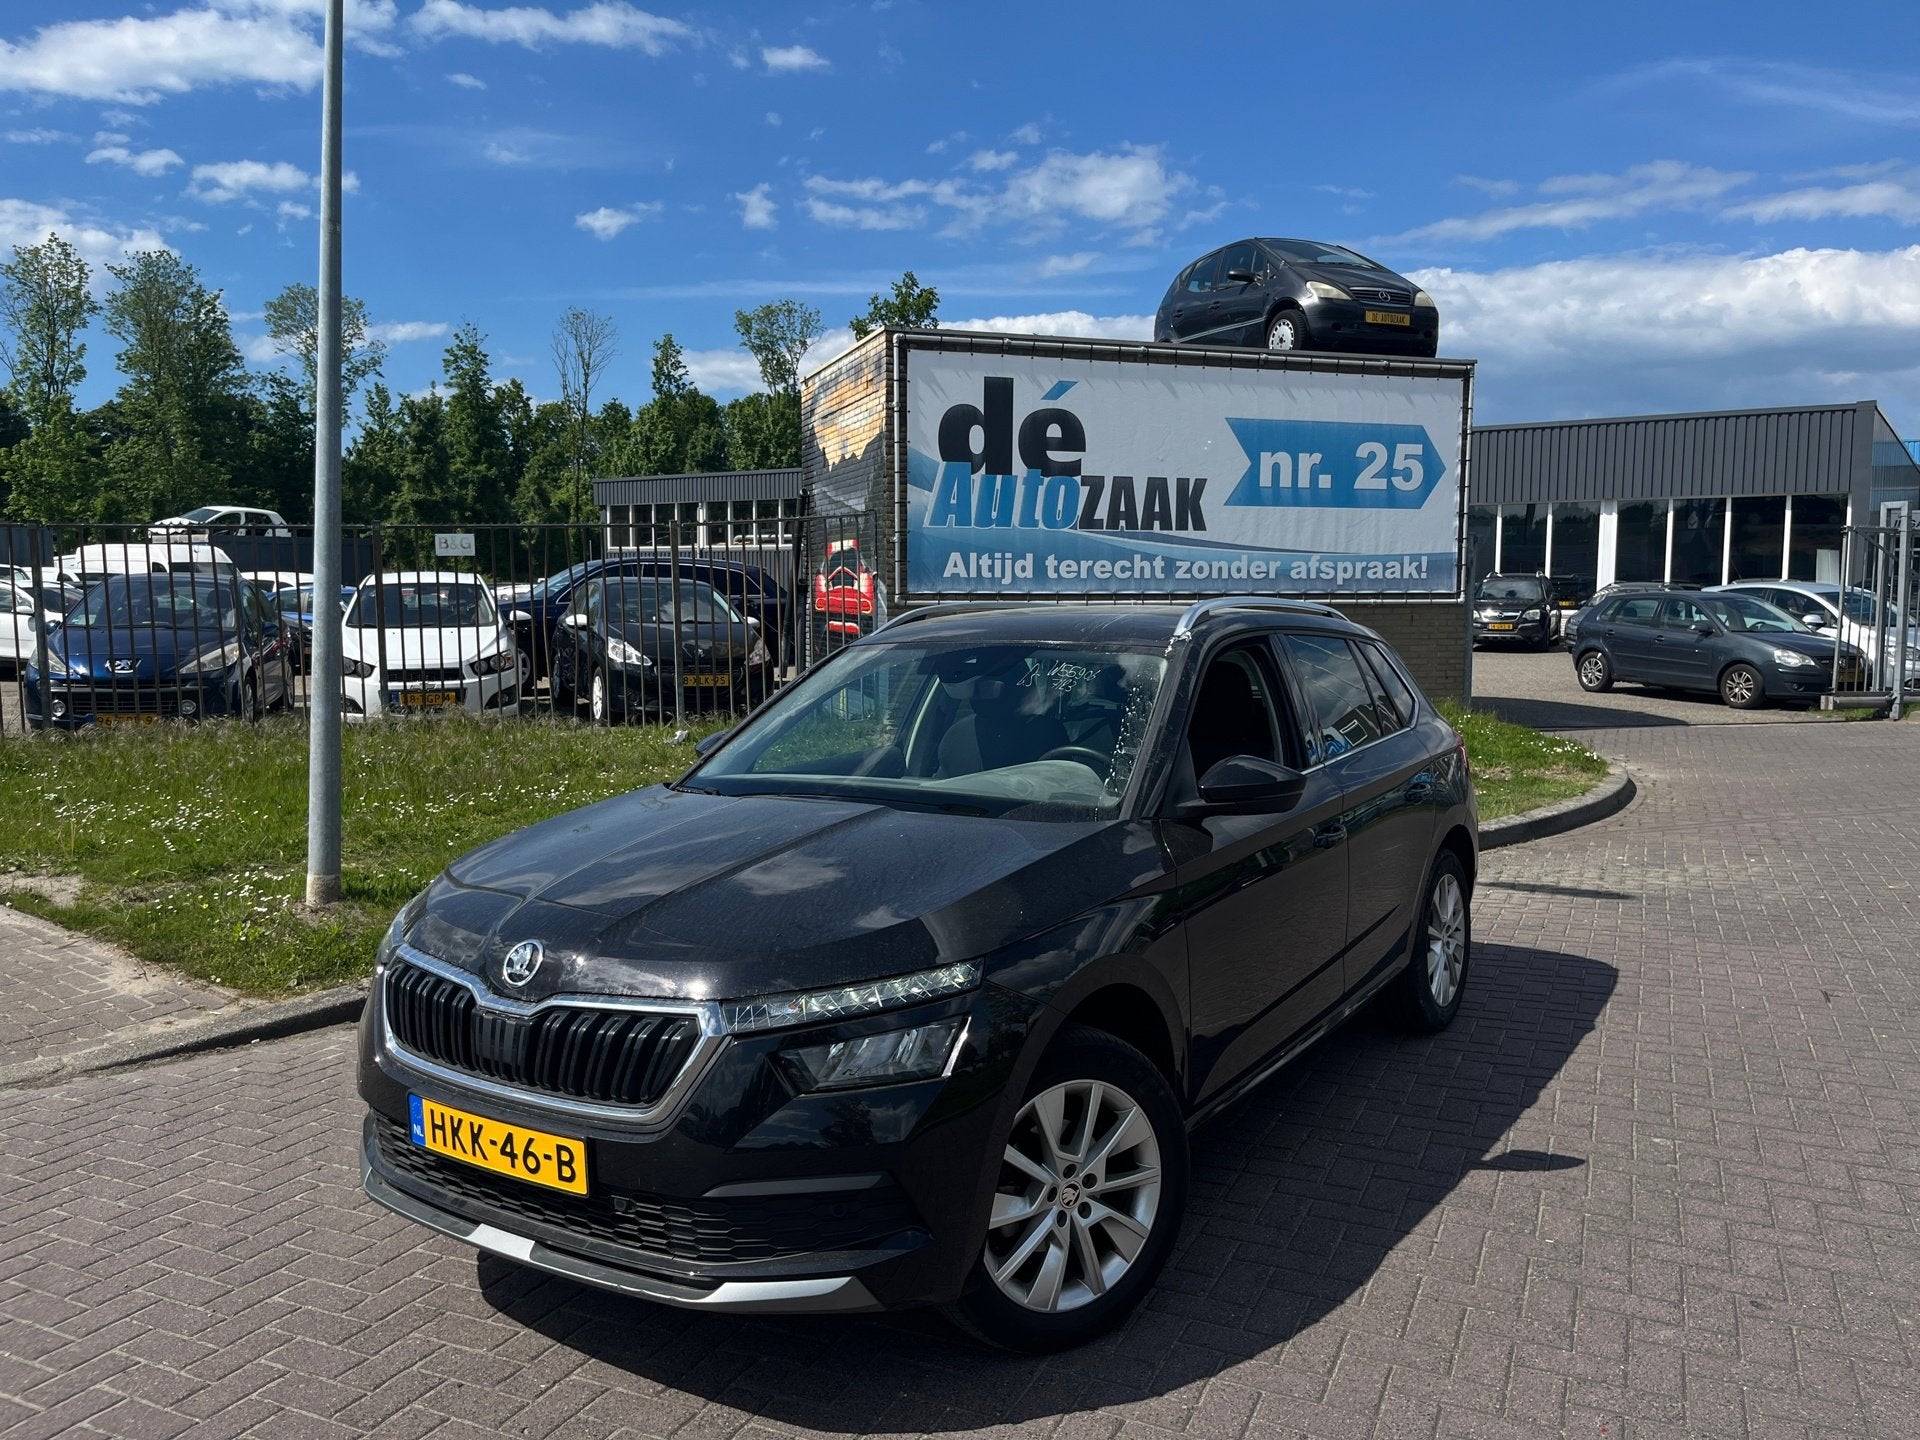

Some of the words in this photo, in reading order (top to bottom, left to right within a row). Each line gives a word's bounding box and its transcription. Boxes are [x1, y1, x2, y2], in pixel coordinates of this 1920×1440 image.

[938, 376, 1086, 477] dé
[1259, 451, 1332, 489] nr.
[1353, 441, 1424, 491] 25
[439, 536, 472, 550] B&G
[943, 552, 1034, 585] Altijd
[1045, 554, 1165, 579] terecht
[1175, 555, 1281, 580] zonder
[1290, 556, 1428, 585] afspraak!
[412, 1122, 424, 1137] NL
[429, 1107, 576, 1184] HKK-46-B
